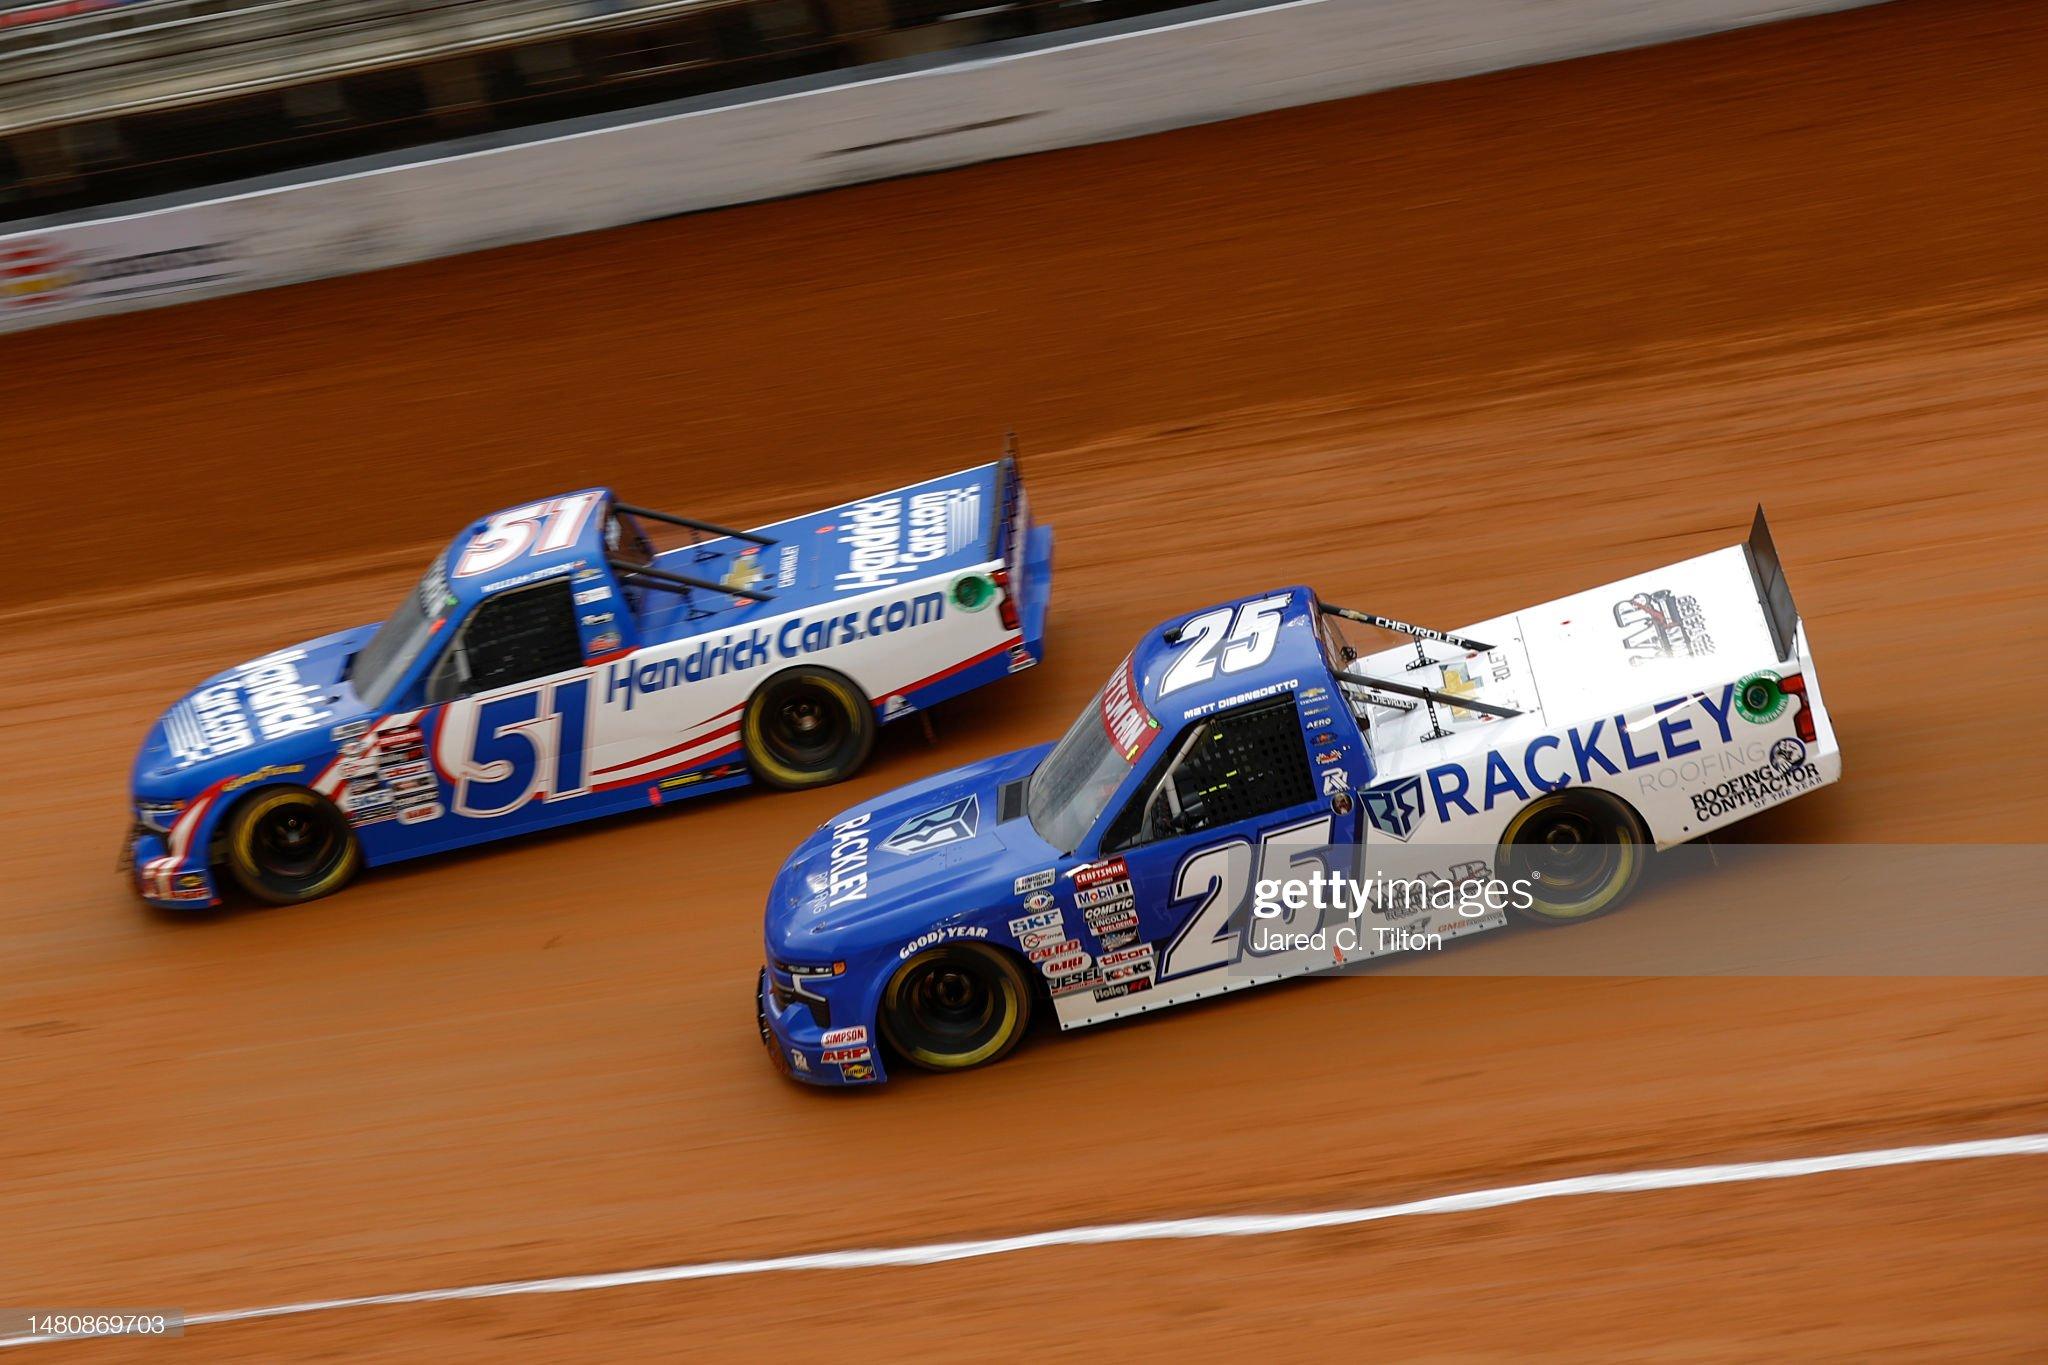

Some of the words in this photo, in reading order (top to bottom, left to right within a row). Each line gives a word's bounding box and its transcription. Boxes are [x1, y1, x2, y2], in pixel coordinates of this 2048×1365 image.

[451, 490, 606, 579] 51
[1375, 616, 1467, 648] CHEVROLET
[1157, 592, 1293, 700] 25
[453, 674, 592, 818] 51
[1426, 683, 1735, 823] RACKLEY
[1638, 742, 1768, 795] ROOFING
[1690, 765, 1773, 810] ROOFING
[1696, 763, 1820, 822] CONTRACTOR
[1794, 777, 1823, 792] YEAR
[829, 813, 871, 907] RACKLEY
[1076, 864, 1124, 883] CRAFTSMAN
[1078, 886, 1114, 905] Mobil
[1160, 814, 1332, 980] 25
[1085, 899, 1133, 919] COMETIC
[1091, 912, 1128, 928] LINCOLN
[1012, 912, 1059, 933] SKF
[1101, 948, 1151, 966] tilton
[1095, 985, 1129, 1000] Holley
[825, 1028, 864, 1045] SIMPSON
[823, 1048, 869, 1062] ARP
